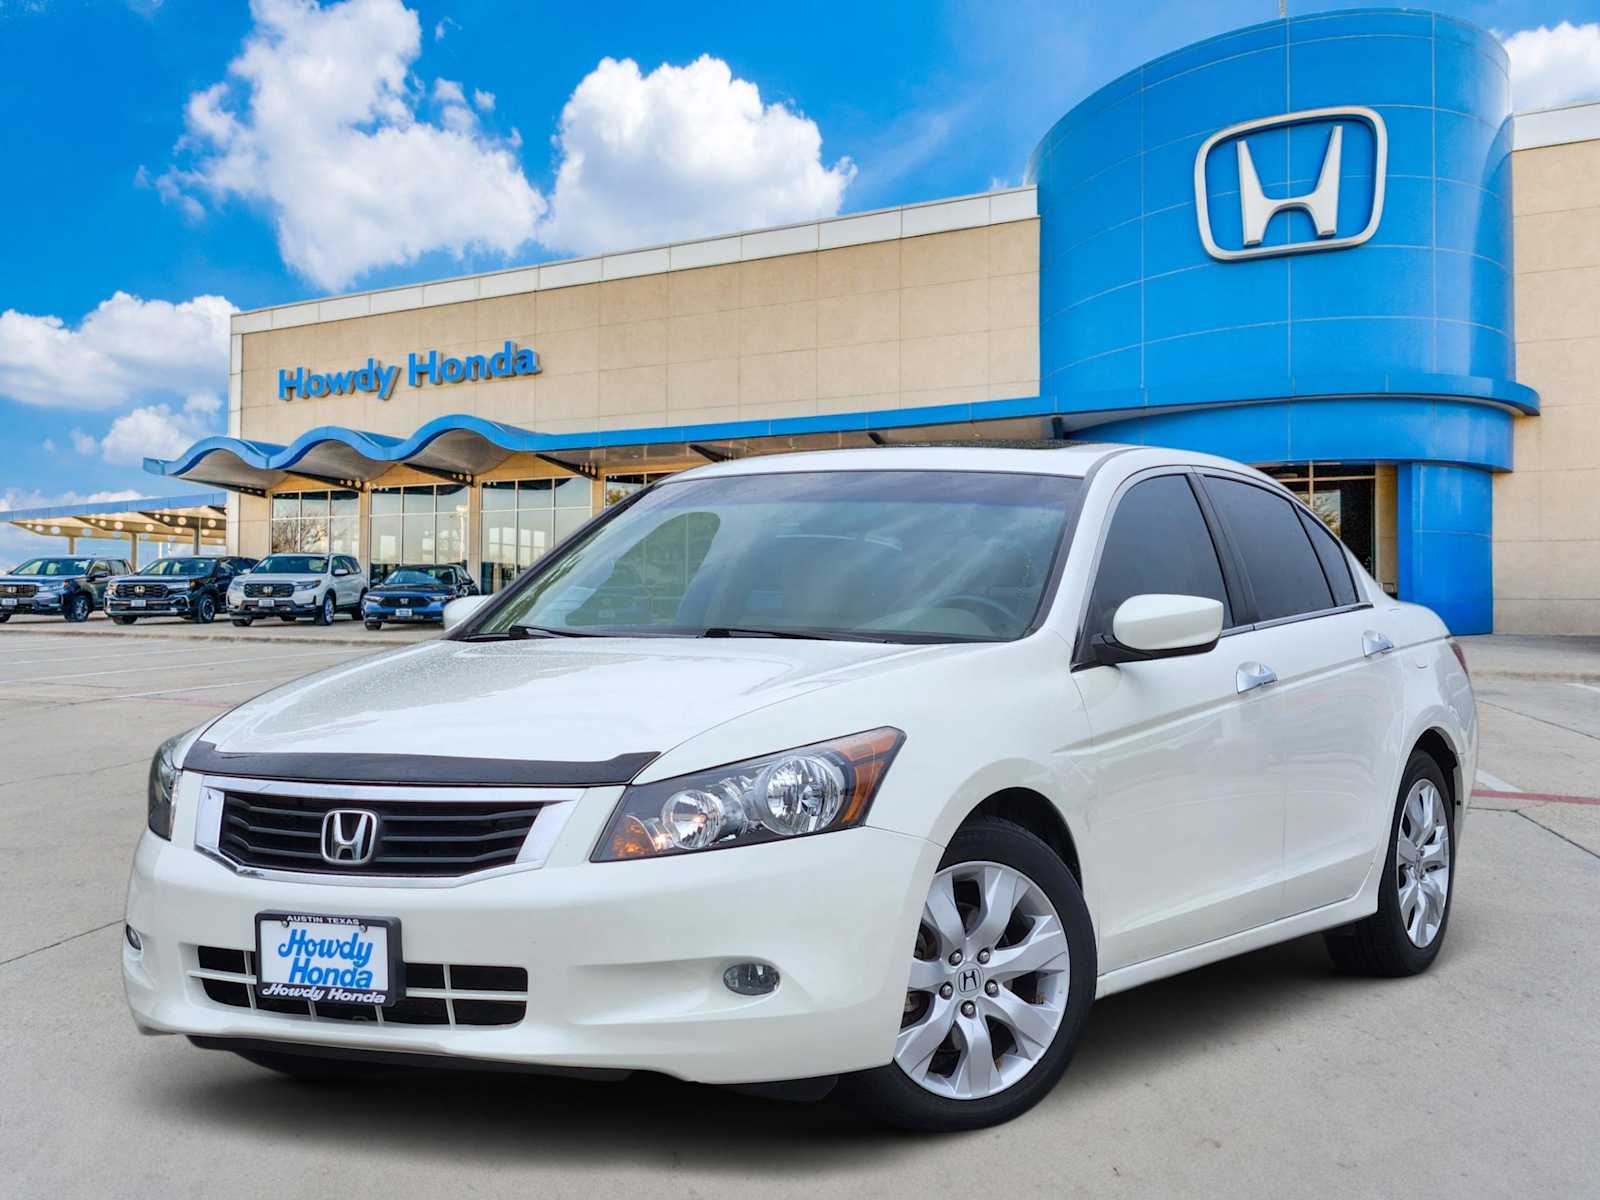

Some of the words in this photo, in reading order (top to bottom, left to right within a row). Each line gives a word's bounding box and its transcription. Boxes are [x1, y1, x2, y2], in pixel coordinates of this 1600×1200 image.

[278, 358, 402, 401] Howdy
[408, 341, 542, 388] Honda
[286, 915, 323, 923] AUSTIN
[326, 917, 360, 925] TEXAS
[278, 928, 373, 968] Howdy
[288, 957, 373, 989] Honda
[262, 984, 326, 1002] Howdy
[327, 988, 386, 1004] Honda
